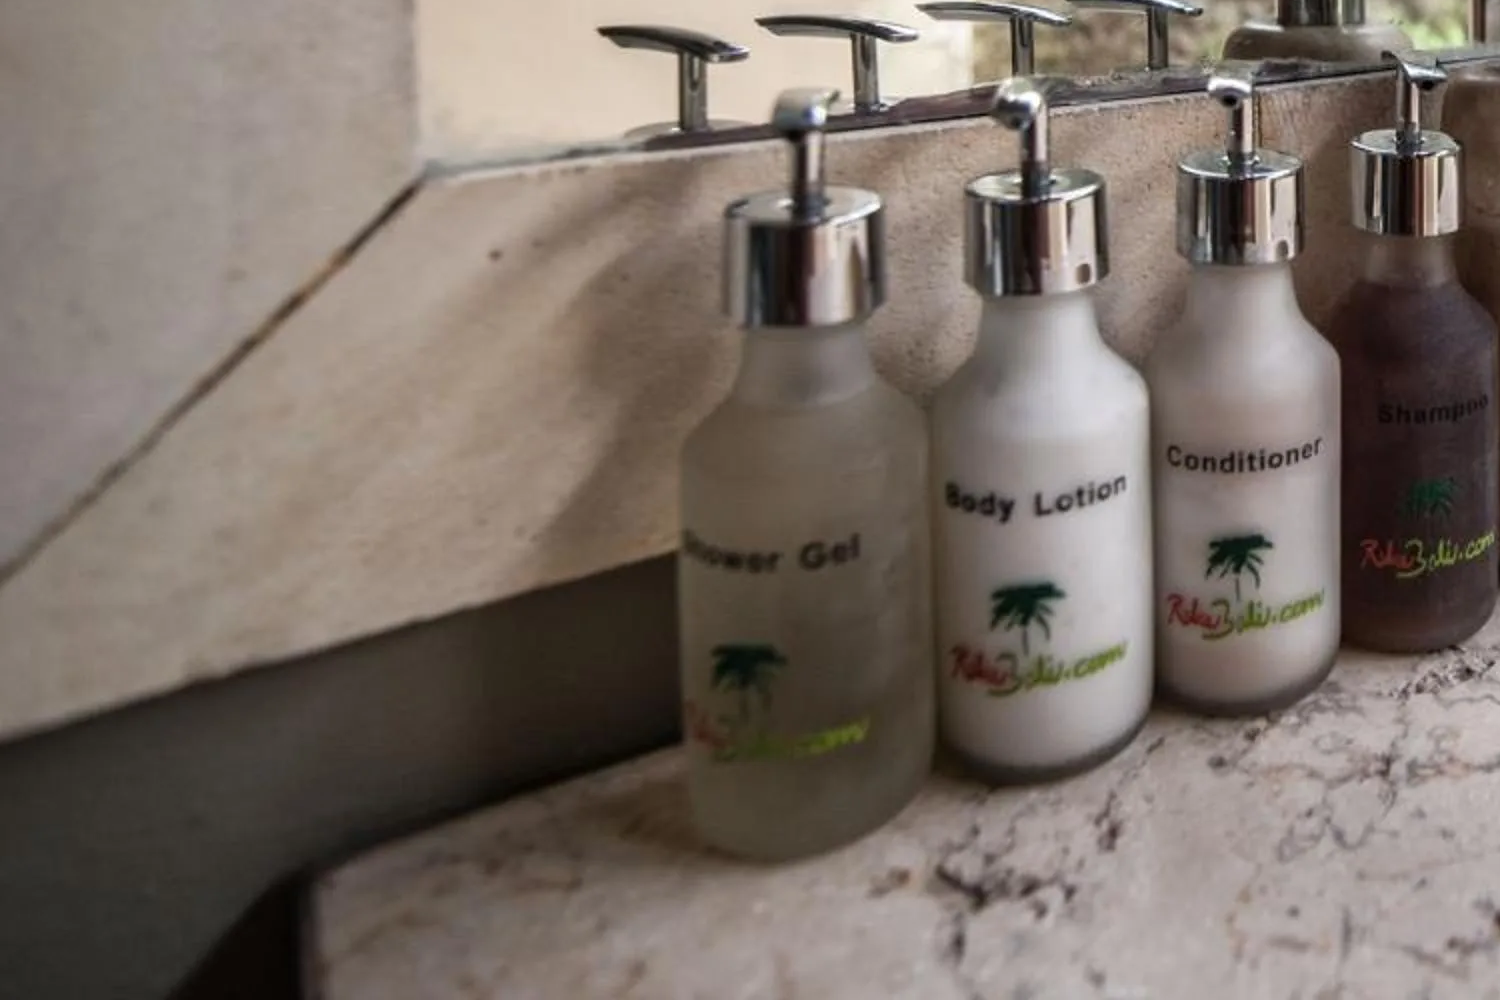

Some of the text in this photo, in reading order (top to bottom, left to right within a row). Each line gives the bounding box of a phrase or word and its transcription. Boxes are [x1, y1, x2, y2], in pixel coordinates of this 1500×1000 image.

[1377, 395, 1489, 424] Shampoo
[1167, 437, 1322, 473] Conditioner
[946, 475, 1127, 524] Body Lotion
[799, 532, 860, 570] Gel
